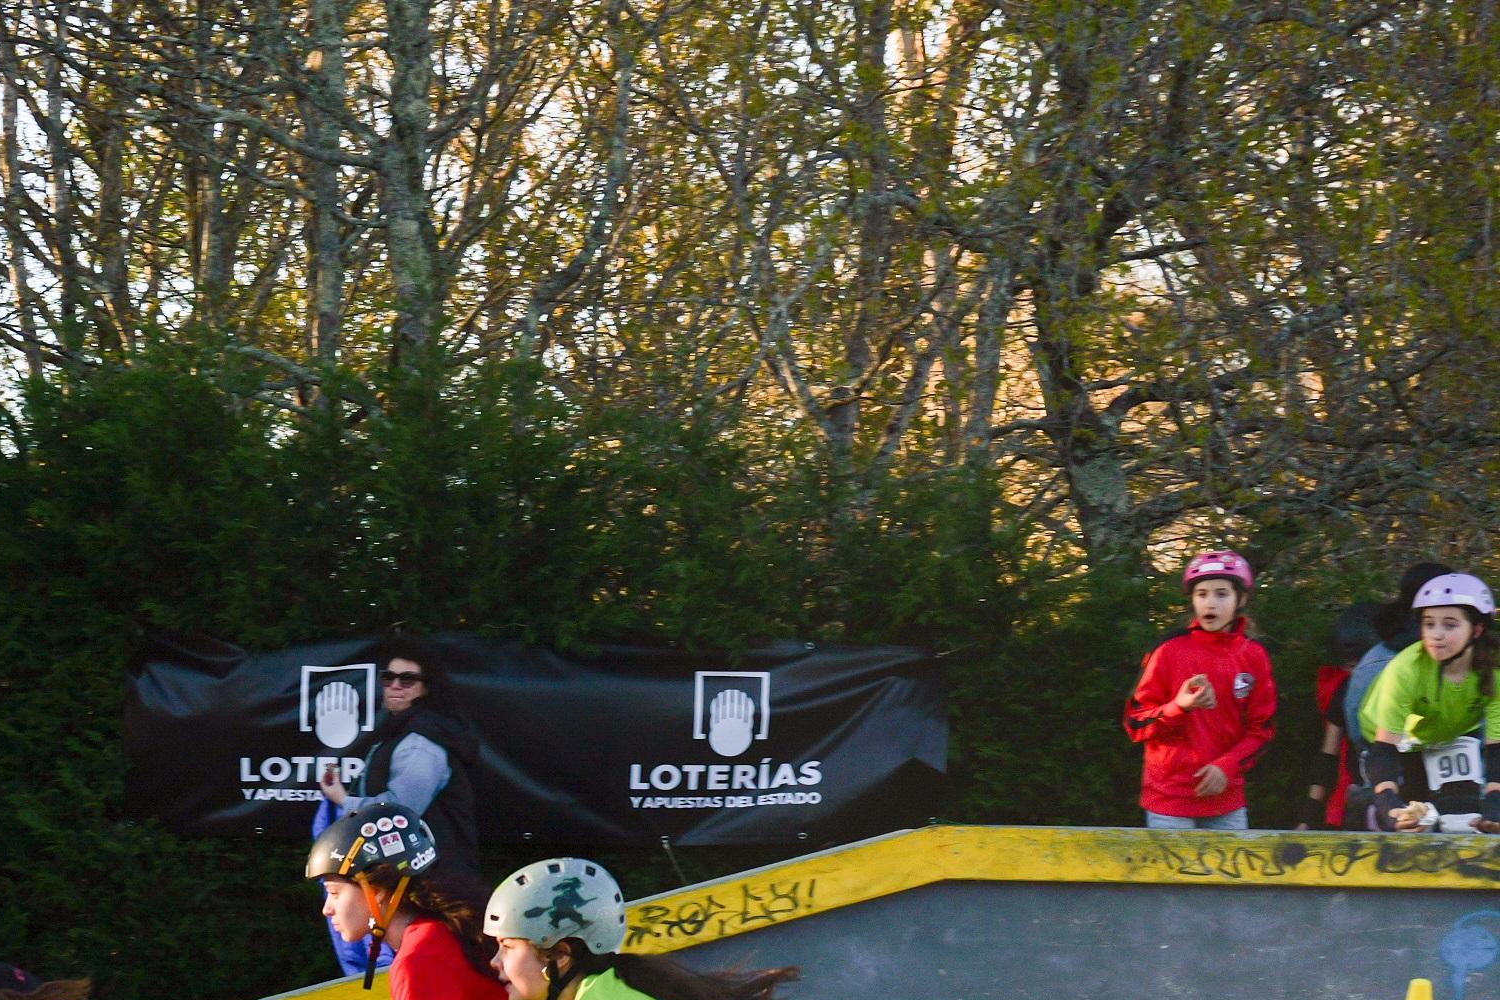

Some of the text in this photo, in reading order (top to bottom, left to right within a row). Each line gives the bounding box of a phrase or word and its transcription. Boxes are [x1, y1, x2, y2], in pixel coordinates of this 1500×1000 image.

[240, 756, 366, 783] LOTER
[629, 758, 823, 791] LOTERÍAS
[1438, 752, 1470, 778] 90
[253, 789, 325, 801] APUESTA
[629, 792, 823, 809] Y APUESTAS DEL ESTADO
